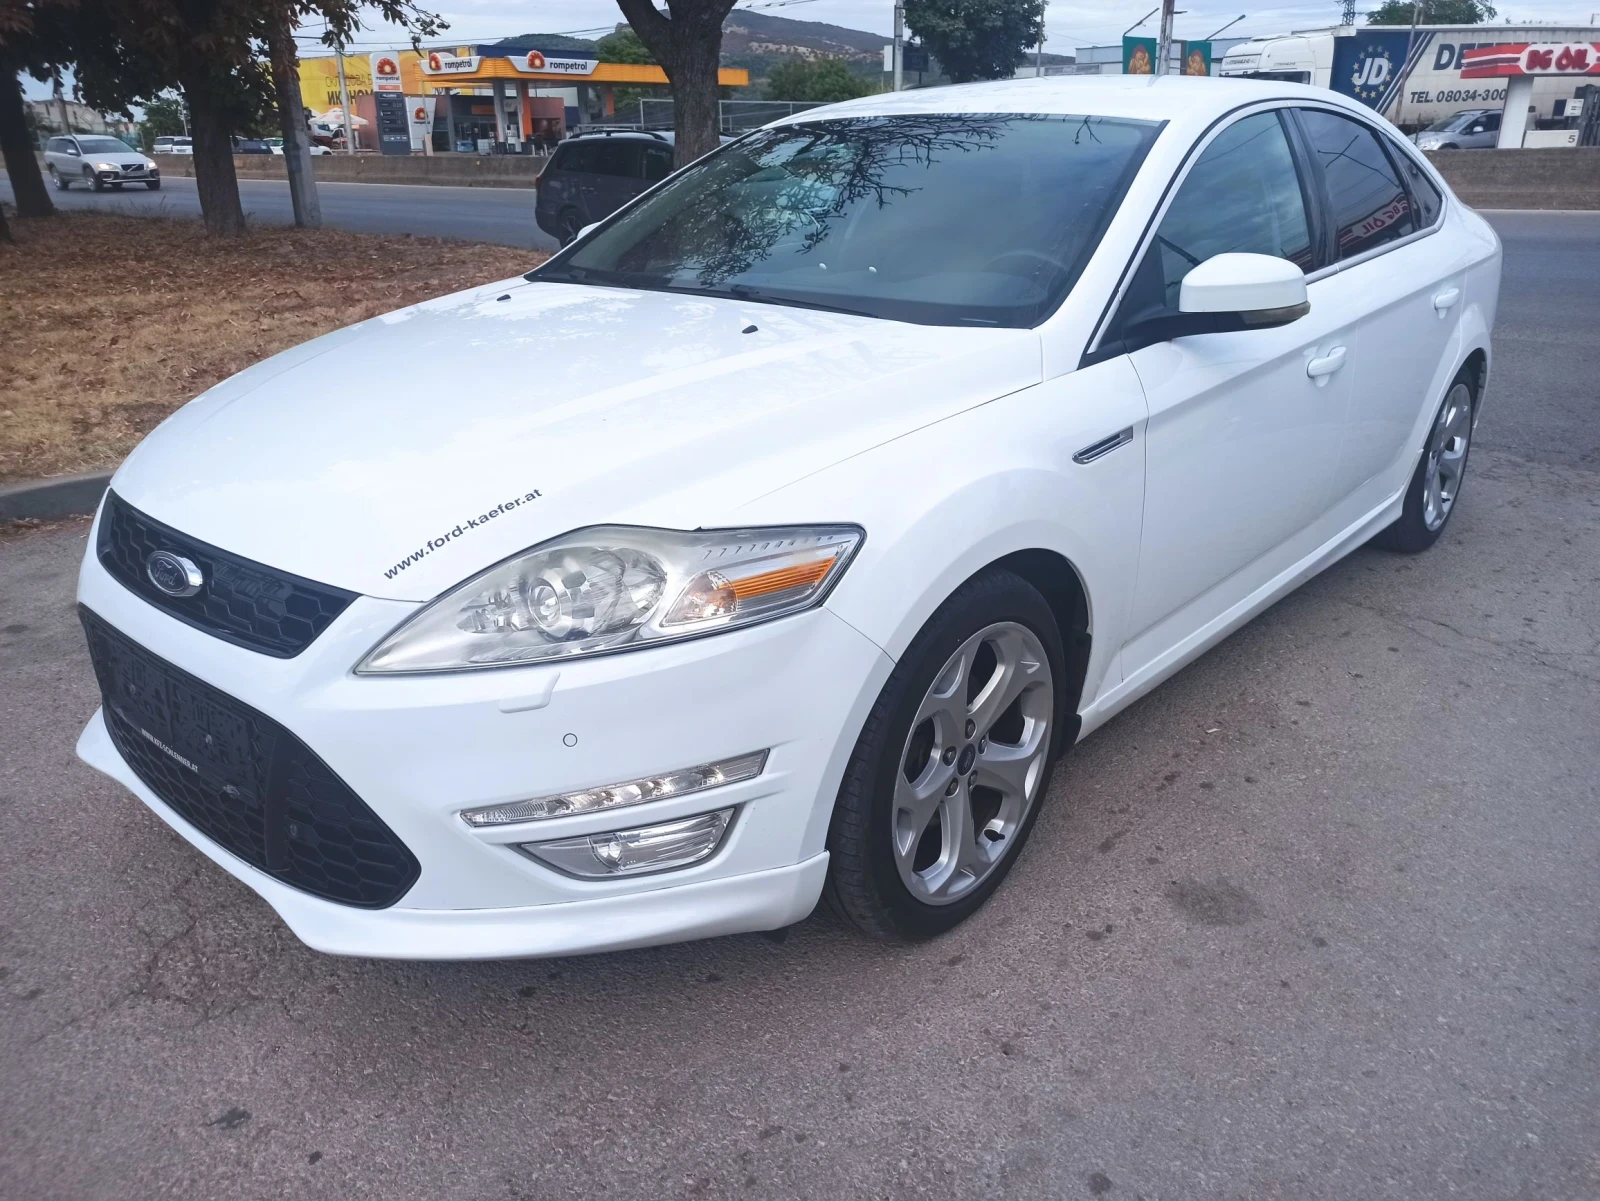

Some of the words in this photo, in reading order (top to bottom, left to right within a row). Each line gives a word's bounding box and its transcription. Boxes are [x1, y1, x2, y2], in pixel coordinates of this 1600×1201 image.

[444, 58, 473, 70] rompetrol
[549, 61, 588, 73] rompetrol
[1525, 49, 1554, 71] BG
[1555, 46, 1590, 71] OIL
[1353, 57, 1390, 86] JD
[1410, 91, 1434, 103] TEL.
[1567, 134, 1576, 144] 5
[383, 488, 543, 580] www.ford-kaefer.at
[154, 559, 178, 586] Ford
